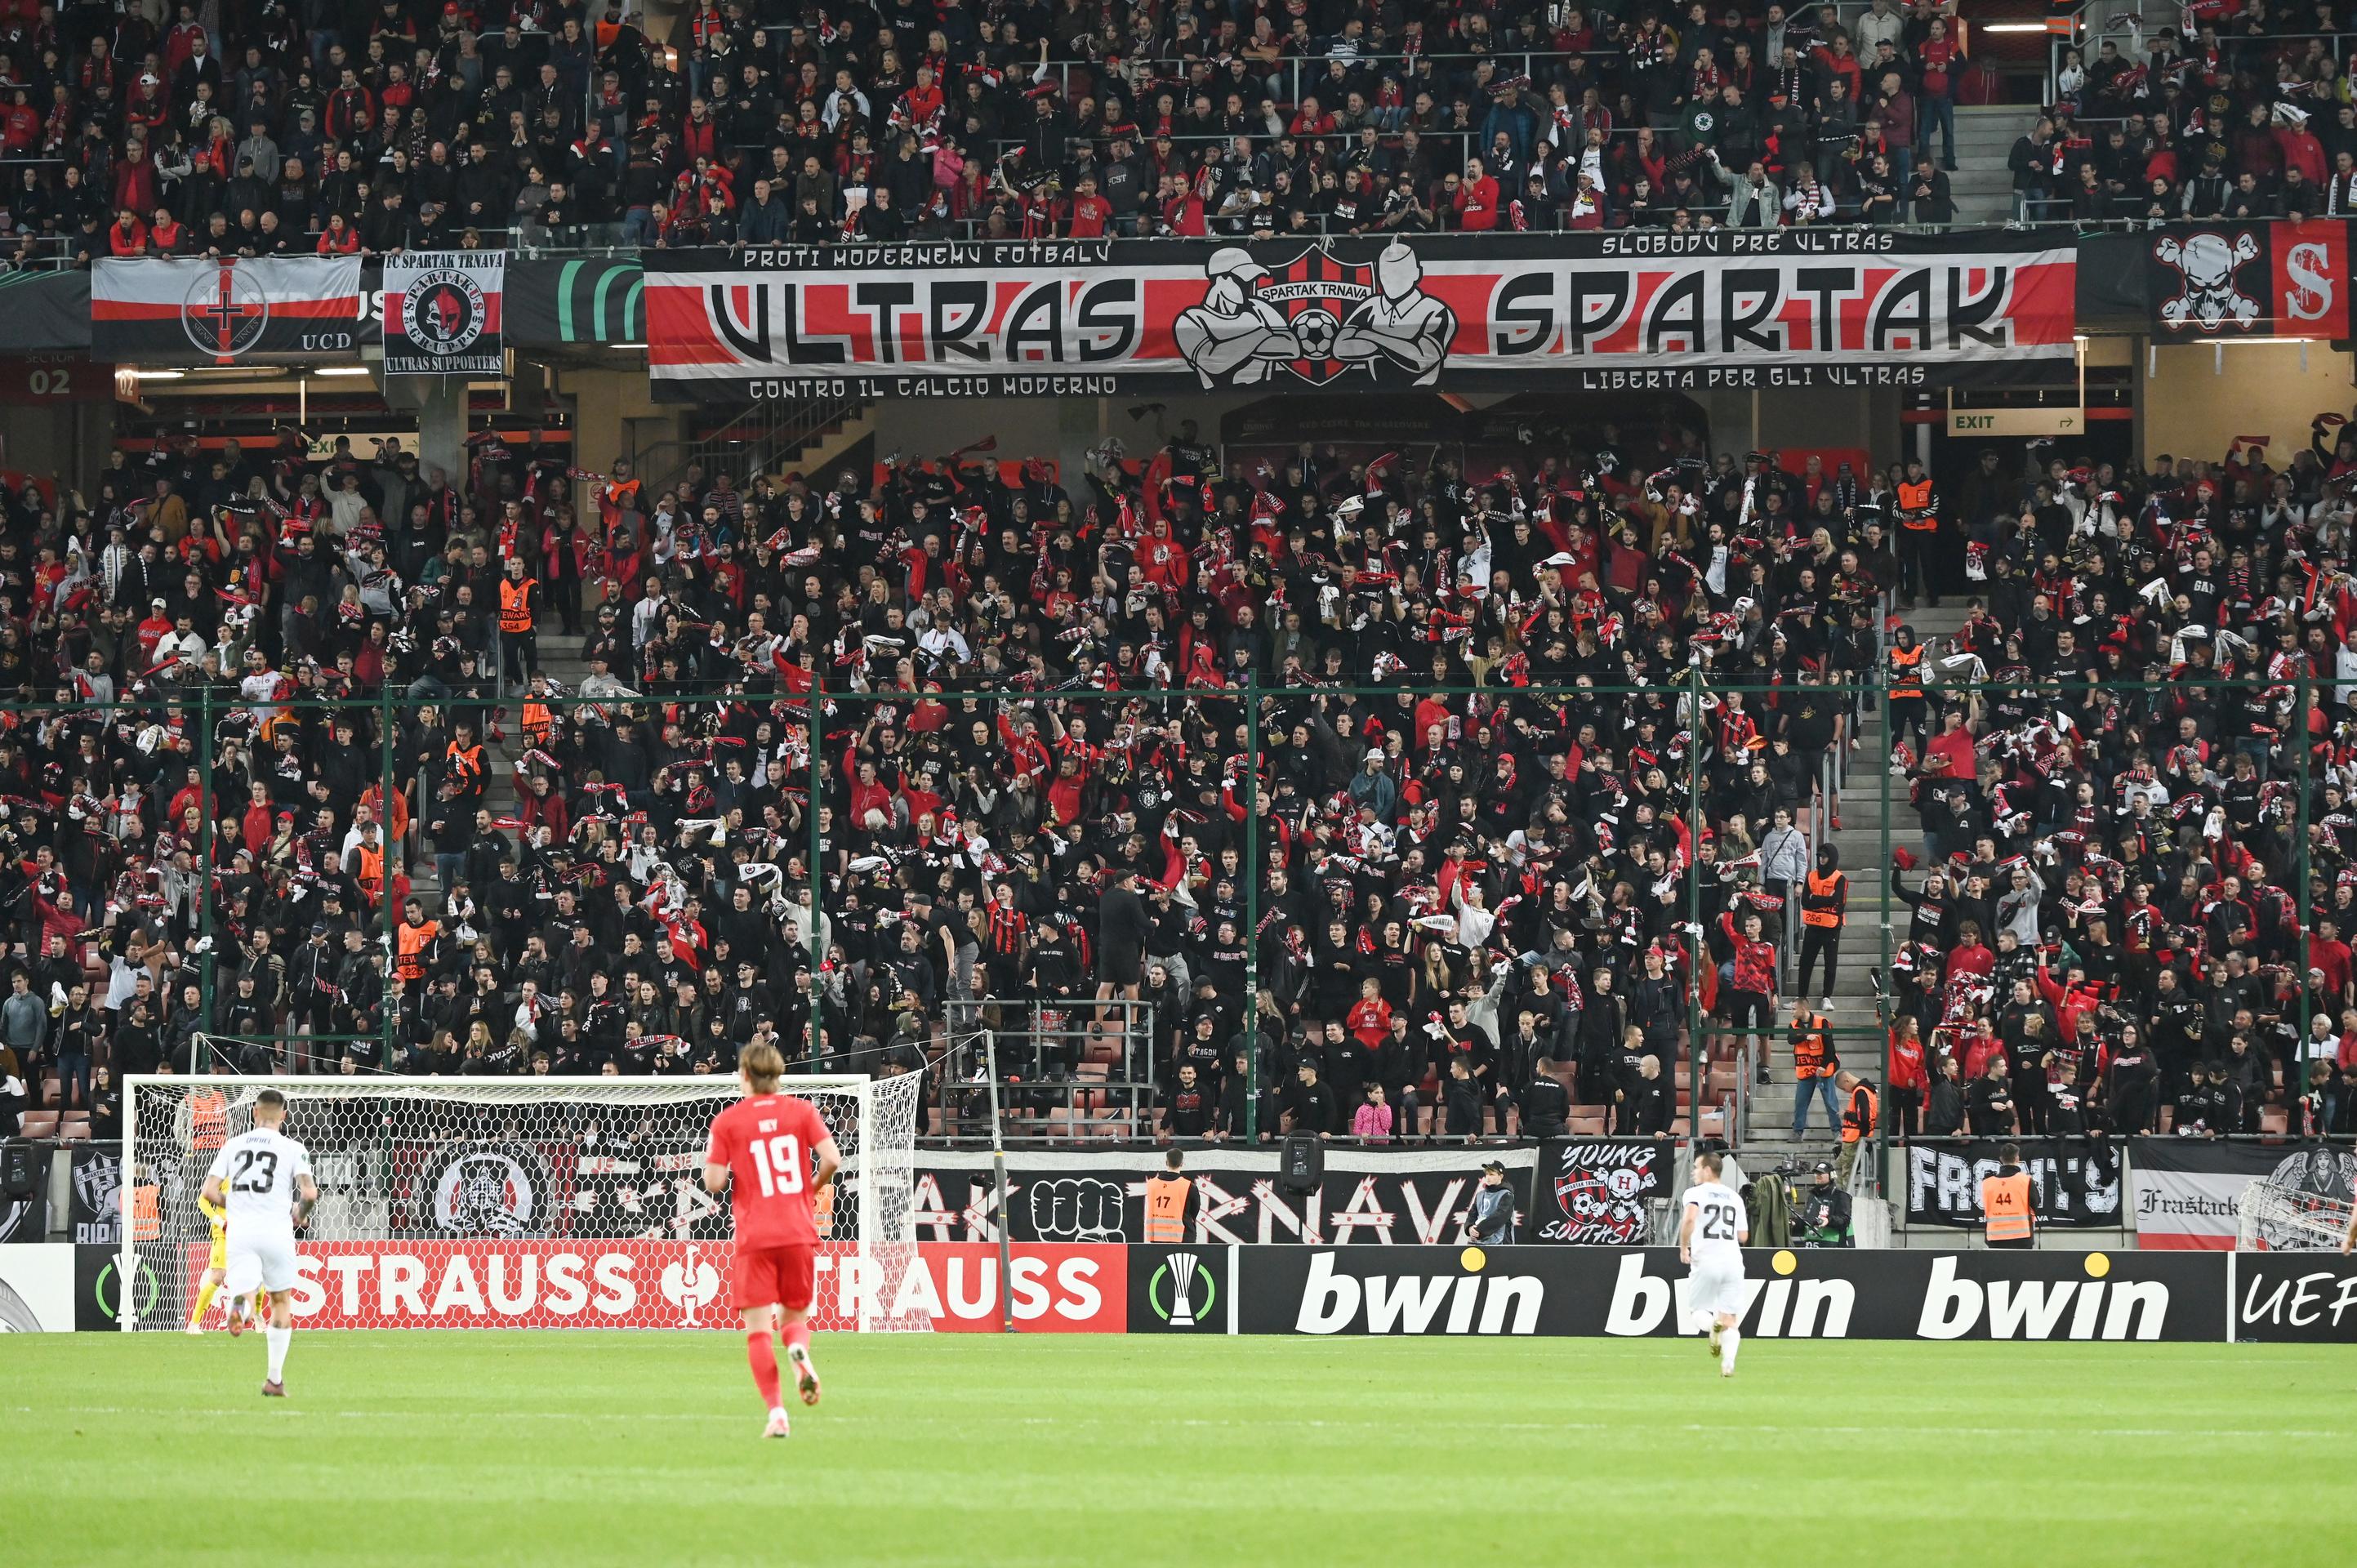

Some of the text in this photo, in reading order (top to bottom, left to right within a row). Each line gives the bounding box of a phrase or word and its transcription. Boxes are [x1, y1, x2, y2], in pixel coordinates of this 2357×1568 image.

[744, 244, 1111, 268] PROTI MODERNEMU FOTBALU
[1602, 232, 1895, 256] SLOBODU PRE ULTRAS
[385, 253, 502, 269] FC SPARTAK TRNAVA
[1261, 283, 1368, 301] SPARTAK TRNAVA
[2286, 243, 2335, 320] S
[709, 276, 1140, 366] ULTRAS
[1494, 265, 2011, 357] SPARTAK
[301, 332, 351, 350] UCD
[385, 355, 501, 372] ULTRAS SUPPORTERS
[29, 369, 71, 395] 02
[120, 371, 134, 396] 02
[750, 376, 1117, 399] CONTRO IL CALCIO MODERNO
[1583, 365, 1925, 390] LIBERTA PER GLI ULTRAS
[1956, 415, 1994, 430] EXIT
[309, 440, 335, 454] EXI
[2193, 579, 2216, 595] GAP
[500, 610, 532, 621] EWARD
[1805, 913, 1822, 923] 286
[749, 1134, 804, 1198] 19
[1561, 1143, 1656, 1170] YOUNG
[232, 1150, 278, 1194] 23
[1618, 1176, 1632, 1190] H
[1564, 1182, 1584, 1192] SPARTAK
[1996, 1193, 2012, 1205] 44
[1156, 1195, 1171, 1209] 17
[1703, 1203, 1736, 1241] 29
[295, 1253, 638, 1316] STRAUSS
[803, 1255, 1103, 1321] TRAUSS
[1294, 1246, 1544, 1334] bwin
[1916, 1252, 2170, 1340] bwin
